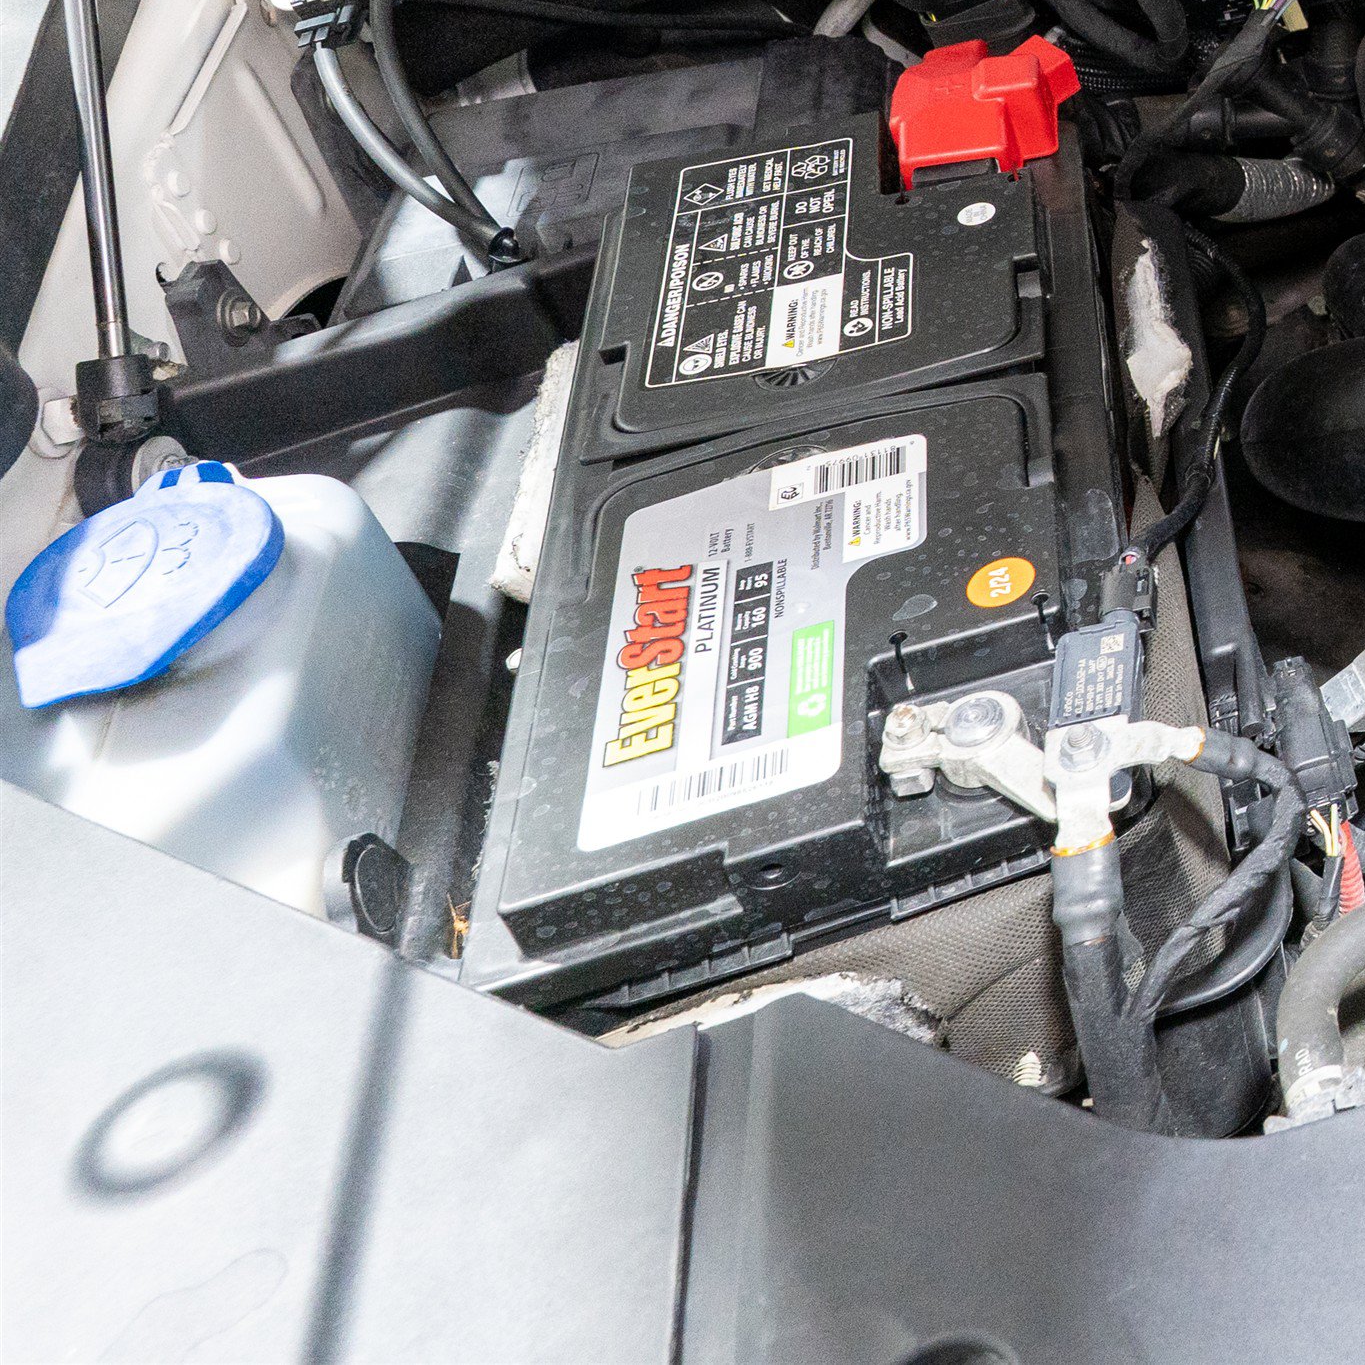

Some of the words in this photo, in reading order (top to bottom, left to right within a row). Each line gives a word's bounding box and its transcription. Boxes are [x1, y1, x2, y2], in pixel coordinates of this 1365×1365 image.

[727, 167, 737, 181] EYES
[764, 157, 774, 180] MEDICAL
[775, 161, 783, 175] FAST.
[725, 182, 735, 199] FLUSH
[746, 181, 755, 195] WITH
[762, 180, 772, 192] GET
[773, 176, 781, 190] HELP
[759, 205, 768, 214] OR
[794, 201, 807, 214] DO
[809, 195, 821, 213] NOT
[822, 188, 835, 213] OPEN.
[745, 216, 755, 235] CAUSE
[755, 214, 767, 245] BLINDNESS
[767, 220, 777, 243] SEVERE
[815, 227, 823, 235] OF
[743, 235, 753, 247] CAN
[789, 232, 798, 245] OUT
[801, 238, 809, 249] THE
[813, 235, 823, 255] REACH
[825, 223, 836, 253] CHILDREN.
[787, 245, 797, 260] KEEP
[801, 249, 808, 258] OF
[738, 263, 749, 286] SPARKS
[750, 260, 761, 283] FLAMES
[762, 254, 773, 281] SMOKING
[896, 268, 907, 290] Battery
[661, 245, 689, 337] DANGER/POISON
[860, 269, 871, 315] INSTRUCTIONS.
[881, 266, 895, 329] NON-SPILLABLE
[895, 291, 904, 305] Acid
[785, 298, 798, 339] WARNING:
[849, 299, 859, 317] READ
[895, 306, 904, 322] Lead
[729, 332, 743, 364] EXPLOSIVE
[736, 300, 746, 313] CAN
[744, 305, 757, 340] BLINDNESS
[755, 325, 766, 348] INJURY.
[713, 347, 726, 368] SHIELD
[742, 340, 753, 361] CAUSE
[754, 348, 763, 359] OR
[813, 513, 822, 534] Walmart
[825, 512, 833, 520] AR
[852, 500, 861, 536] WARNING:
[874, 507, 882, 544] Reproductive
[707, 531, 719, 557] 12-VOLT
[720, 527, 734, 553] Battery
[813, 533, 822, 541] by
[823, 519, 833, 550] Bentonville,
[811, 540, 821, 569] Distributed
[754, 572, 768, 588] 95
[774, 558, 787, 618] NONSPILLABLE
[988, 566, 1012, 598] 2/24
[694, 566, 720, 654] PLATINUM
[751, 605, 766, 628] 160
[602, 564, 693, 768] EverStart
[731, 647, 741, 668] Cranking
[747, 646, 763, 670] 900
[730, 668, 738, 680] Cold
[745, 684, 759, 702] H8
[729, 694, 738, 717] Number
[727, 717, 736, 731] Part
[742, 702, 759, 731] AGM
